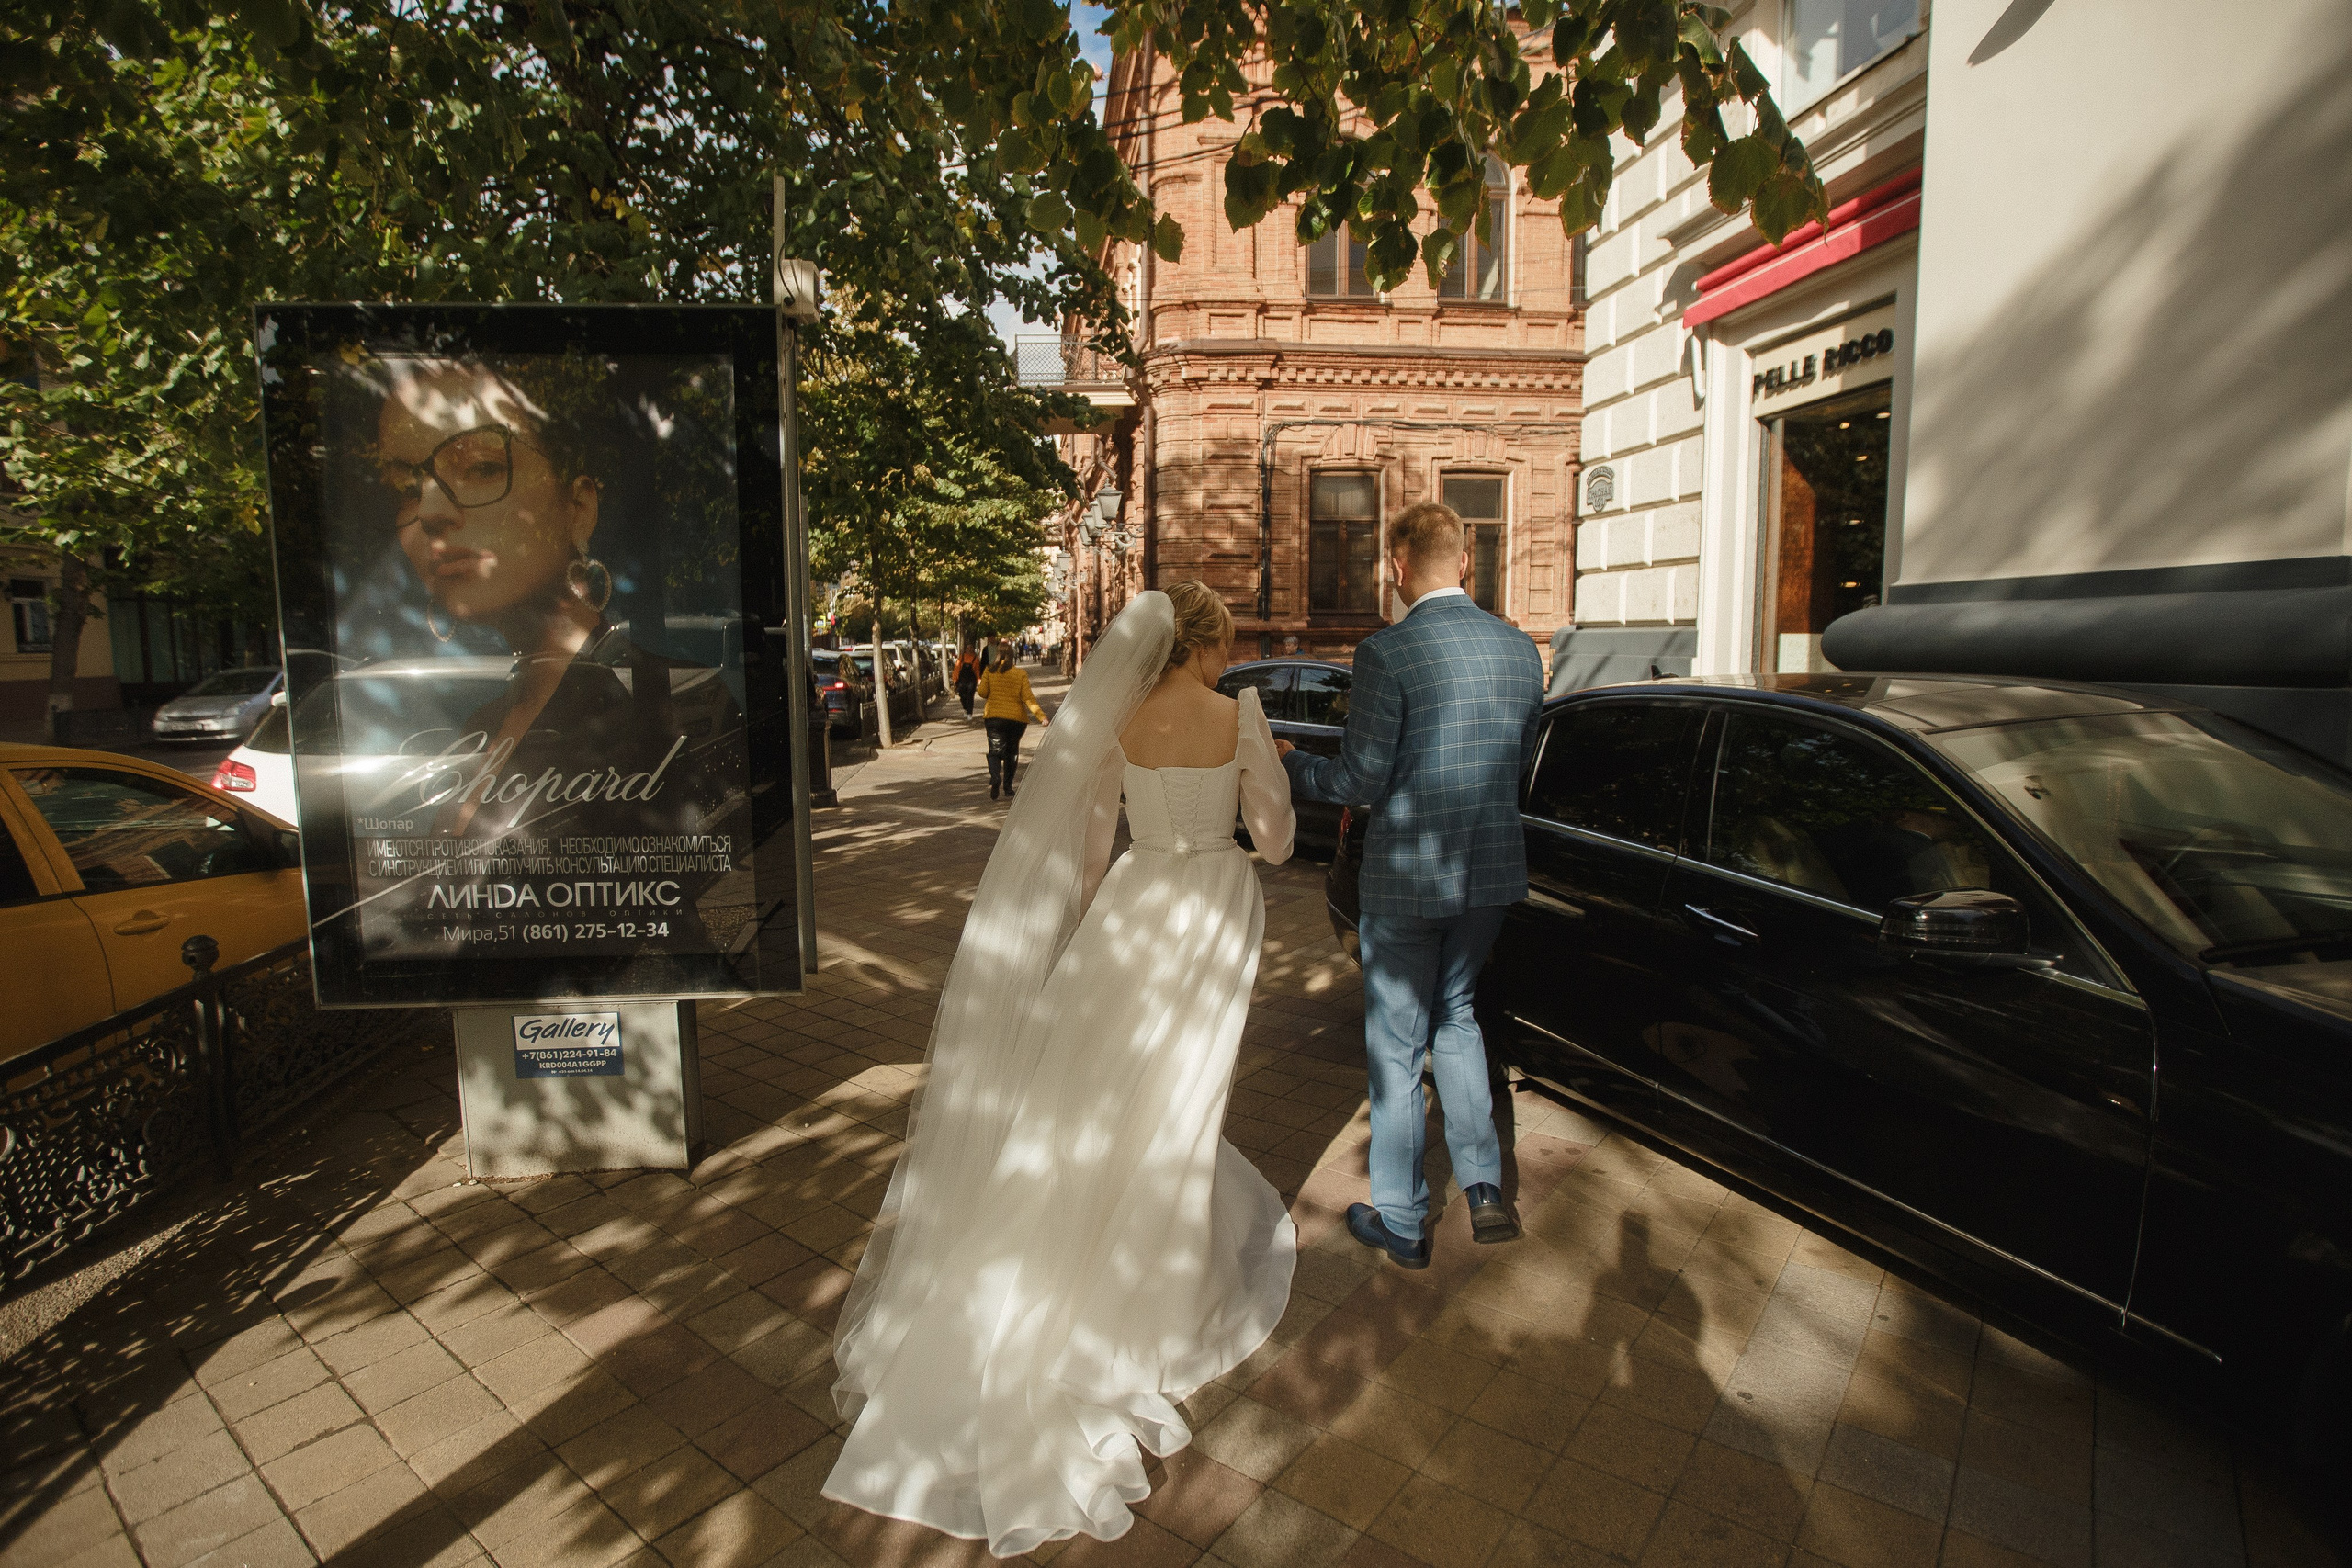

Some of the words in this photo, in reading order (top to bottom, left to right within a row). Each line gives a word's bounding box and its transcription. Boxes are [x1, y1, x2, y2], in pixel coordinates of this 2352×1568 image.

[1752, 353, 1817, 395] PELLE
[398, 728, 687, 828] Chopard
[368, 840, 424, 858] ИМЕЮТСЯ
[560, 836, 639, 856] НЕОБХОДИМО
[641, 835, 731, 854] ОЗНАКОМИТЬСЯ
[379, 858, 462, 879] ИНСТРУКЦИЕЙ
[464, 858, 491, 875] ИЛИ
[492, 857, 554, 875] ПОЛУЧИТЬ
[555, 855, 648, 875] КОНСУЛЬТАЦИЮ
[649, 854, 732, 874] СПЕЦИАЛИСТА
[546, 880, 681, 908] ОПТИКС
[523, 923, 569, 943] (861)
[575, 922, 670, 939] 275-12-34
[519, 1017, 615, 1045] Gallery
[522, 1049, 617, 1061] +7(861)224-91-84
